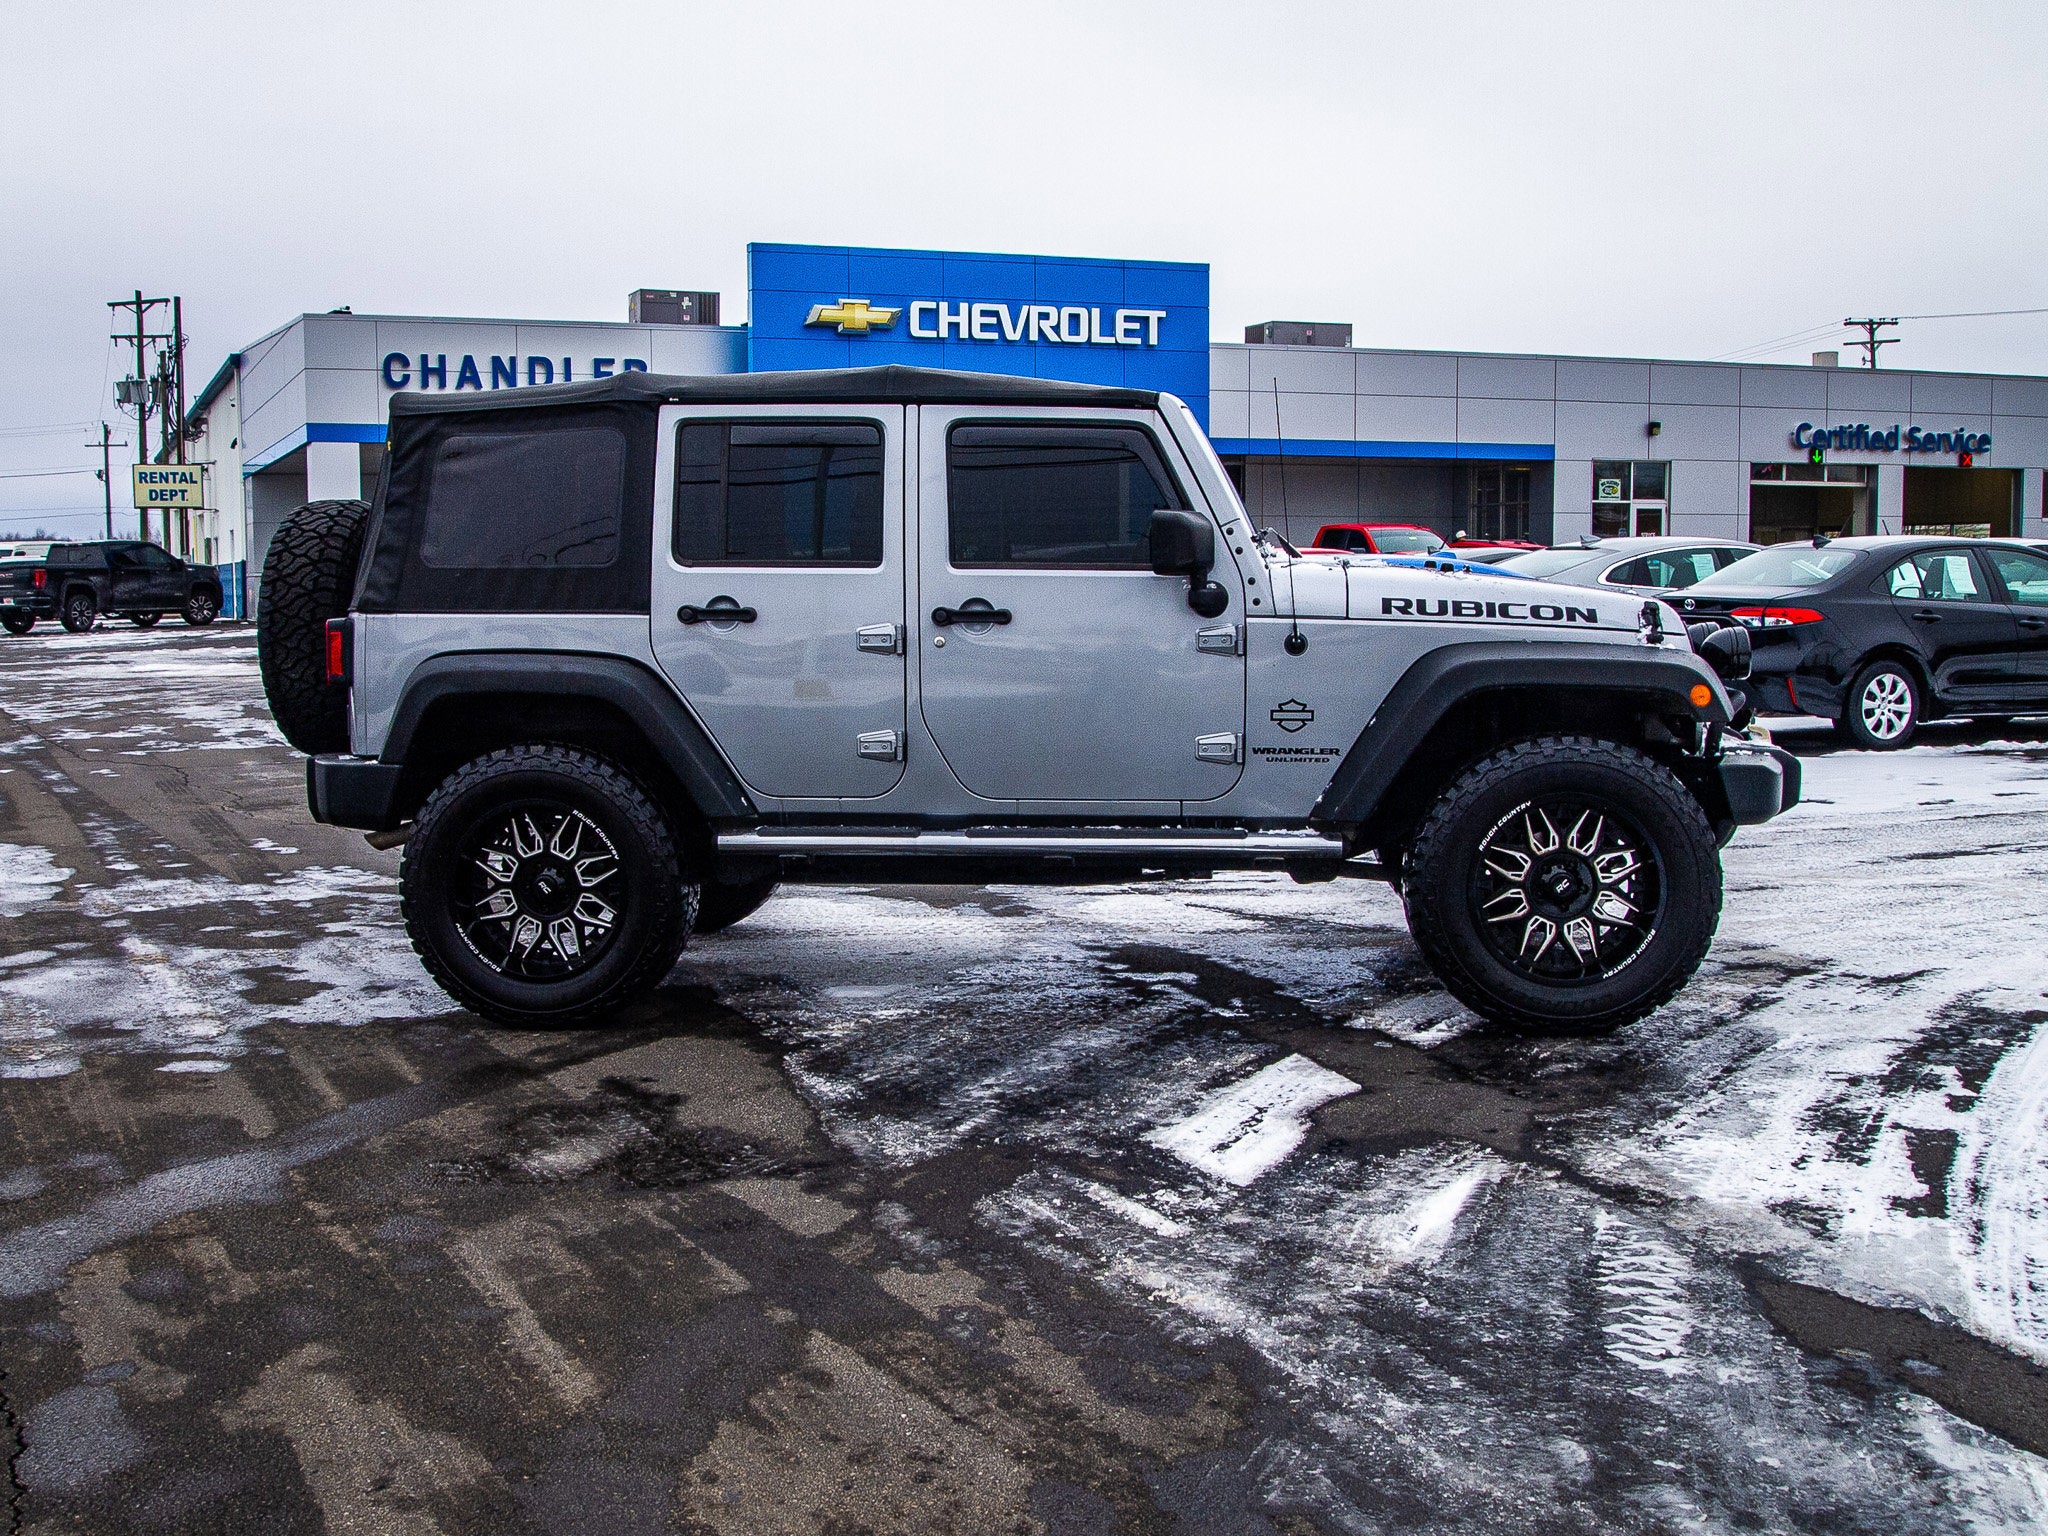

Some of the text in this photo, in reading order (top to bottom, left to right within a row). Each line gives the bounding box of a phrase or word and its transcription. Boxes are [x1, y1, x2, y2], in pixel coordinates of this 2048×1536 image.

[909, 300, 1167, 345] CHEVROLET
[1795, 422, 1992, 453] Certified Service
[138, 471, 198, 484] RENTAL
[148, 489, 189, 501] DEPT.
[1381, 597, 1599, 623] RUBICON
[1251, 747, 1341, 756] WRANGLER
[572, 809, 620, 860] ROUGH COUNTRY
[1478, 800, 1532, 851] ROUGH COUNTRY
[538, 881, 552, 894] RC
[1556, 878, 1570, 894] RC
